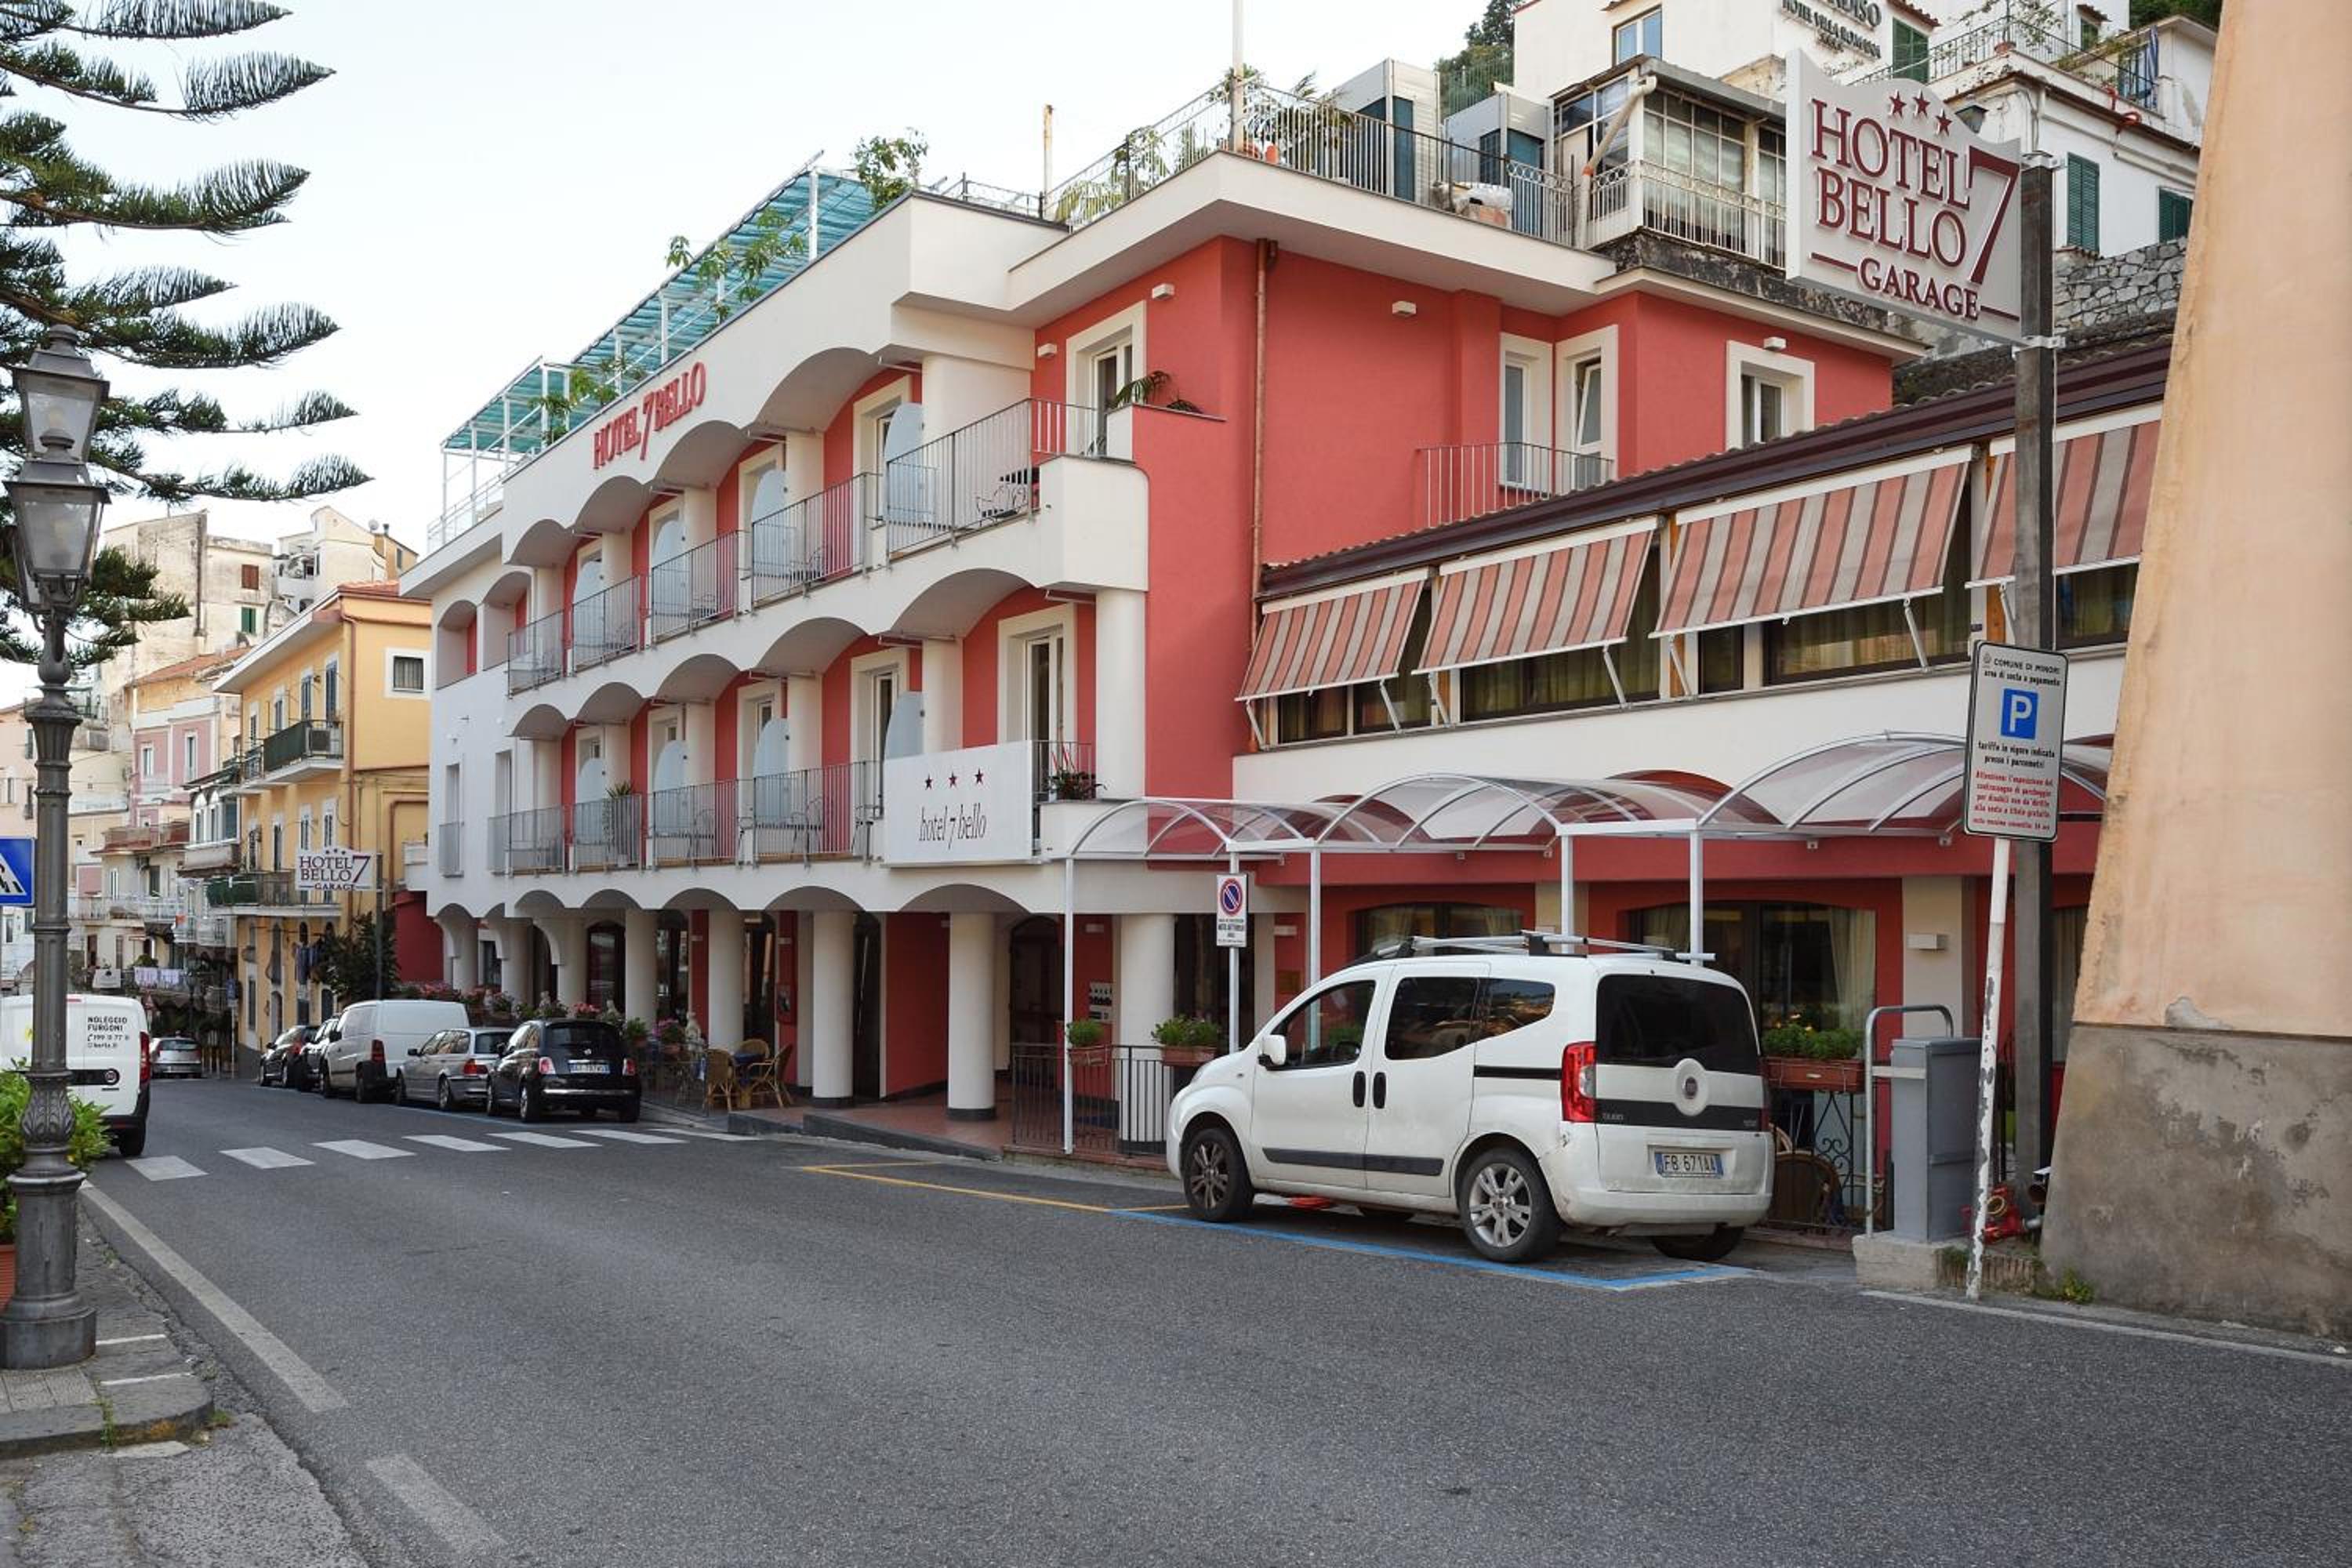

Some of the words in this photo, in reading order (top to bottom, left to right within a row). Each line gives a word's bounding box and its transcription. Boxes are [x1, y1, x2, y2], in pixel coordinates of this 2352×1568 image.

[1810, 97, 1970, 211] HOTEL
[1817, 165, 1967, 268] BELLO
[1966, 144, 2021, 286] 7
[1857, 256, 1979, 321] GARAGE
[593, 406, 641, 470] HOTEL
[639, 391, 655, 462] 7
[654, 361, 706, 432] BELLO
[1994, 659, 2023, 670] COMUNE
[2009, 694, 2033, 733] P
[919, 805, 948, 841] hotel
[957, 802, 987, 840] bello
[299, 855, 353, 869] HOTEL
[300, 868, 352, 882] BELLO
[352, 855, 372, 884] 7
[314, 883, 355, 891] GARAGE
[88, 1016, 128, 1025] NOLEGGIO
